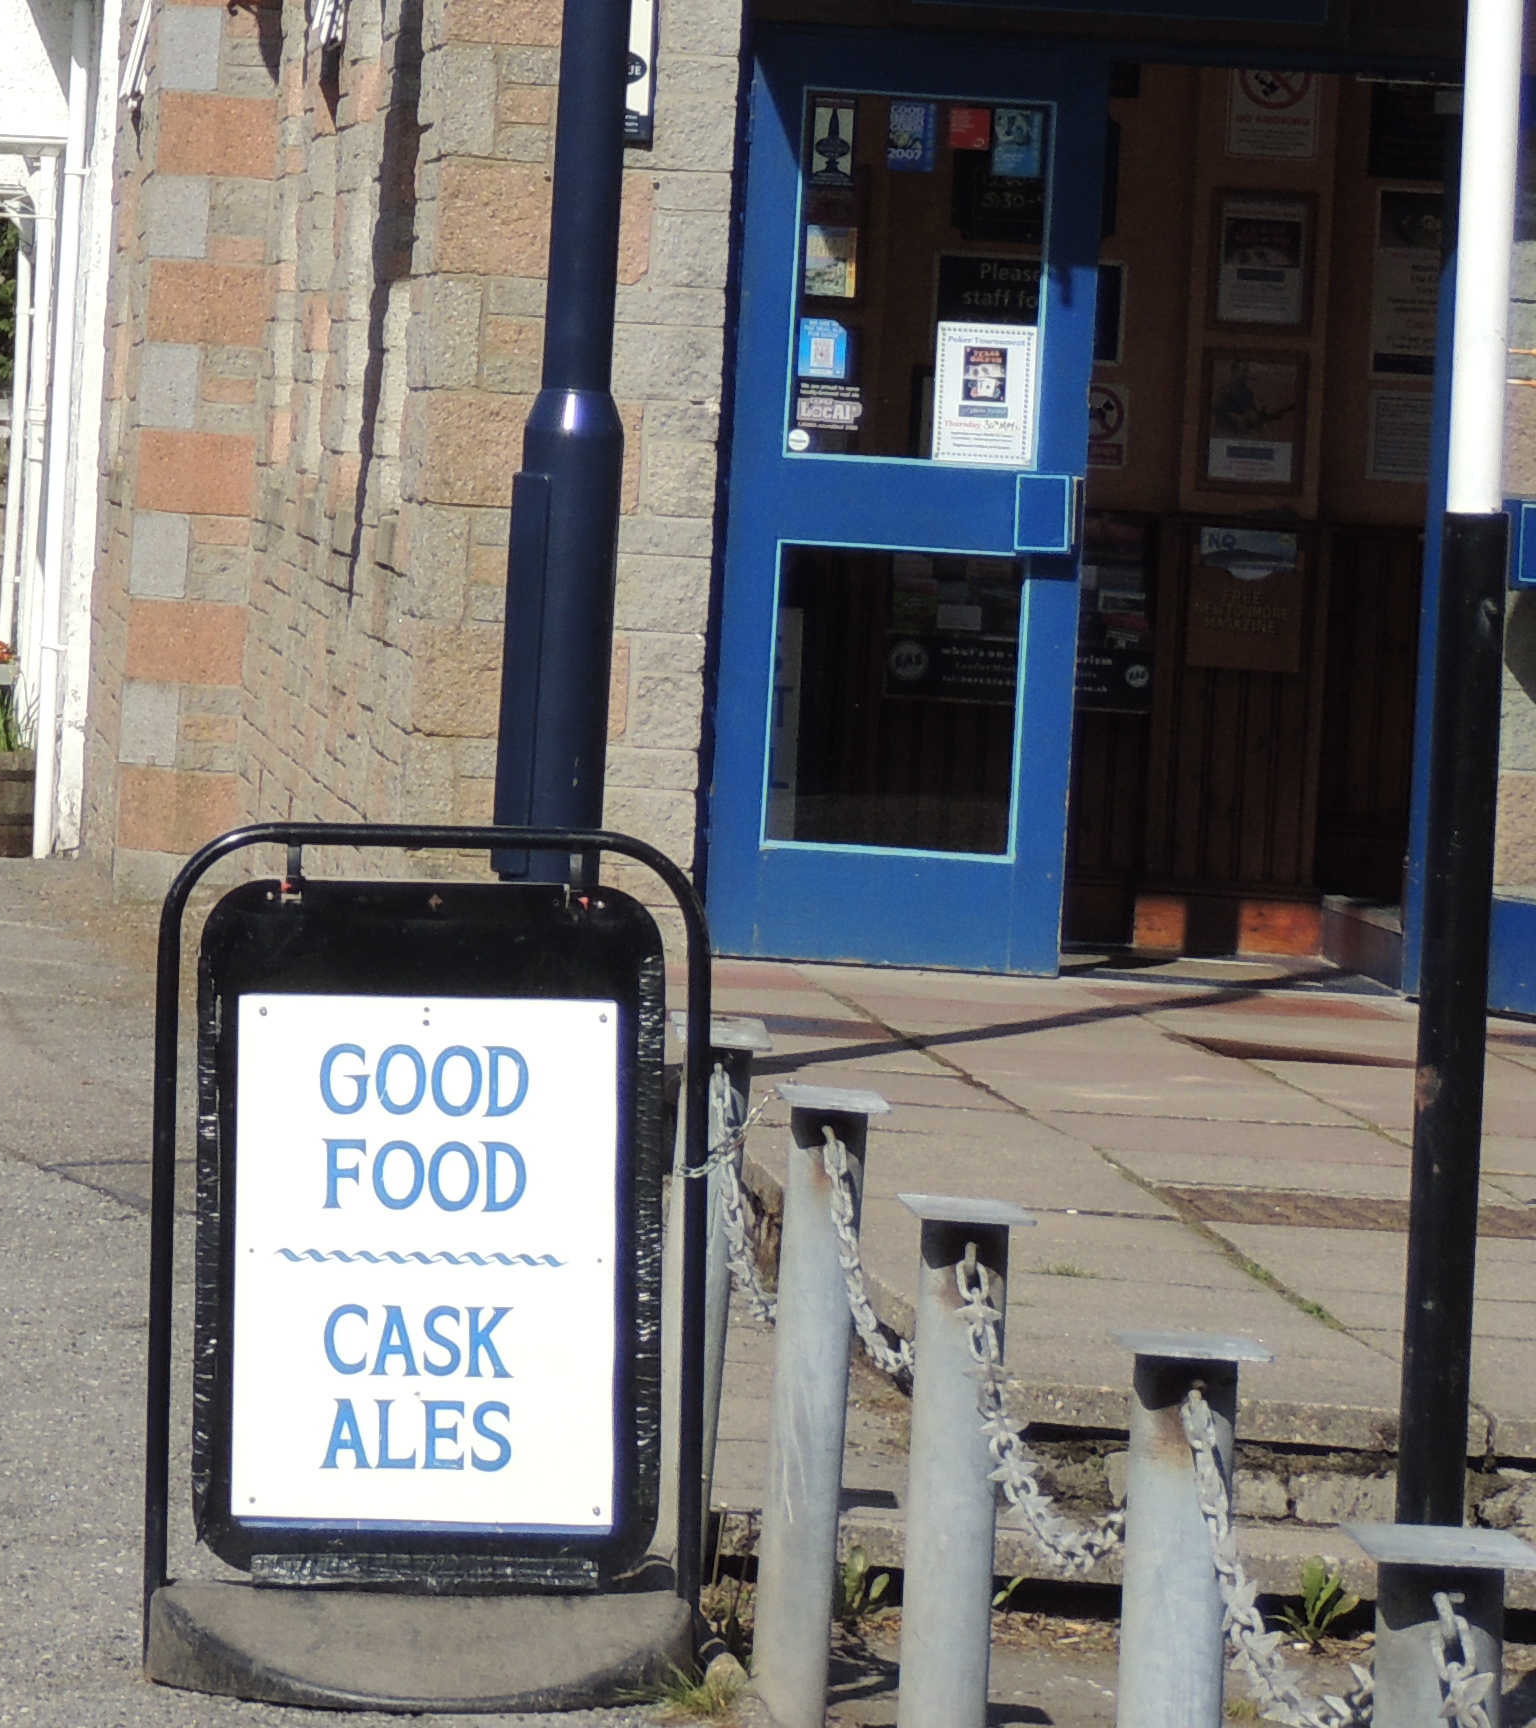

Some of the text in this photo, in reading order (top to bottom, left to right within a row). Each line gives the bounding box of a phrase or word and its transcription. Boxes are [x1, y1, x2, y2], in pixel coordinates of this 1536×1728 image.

[887, 147, 923, 161] 2007
[962, 288, 1012, 308] staff
[948, 335, 1026, 346] Poker Tournament
[319, 1042, 530, 1118] GOOD
[321, 1136, 527, 1213] FOOD
[322, 1302, 516, 1380] CASK
[318, 1397, 513, 1473] ALES
